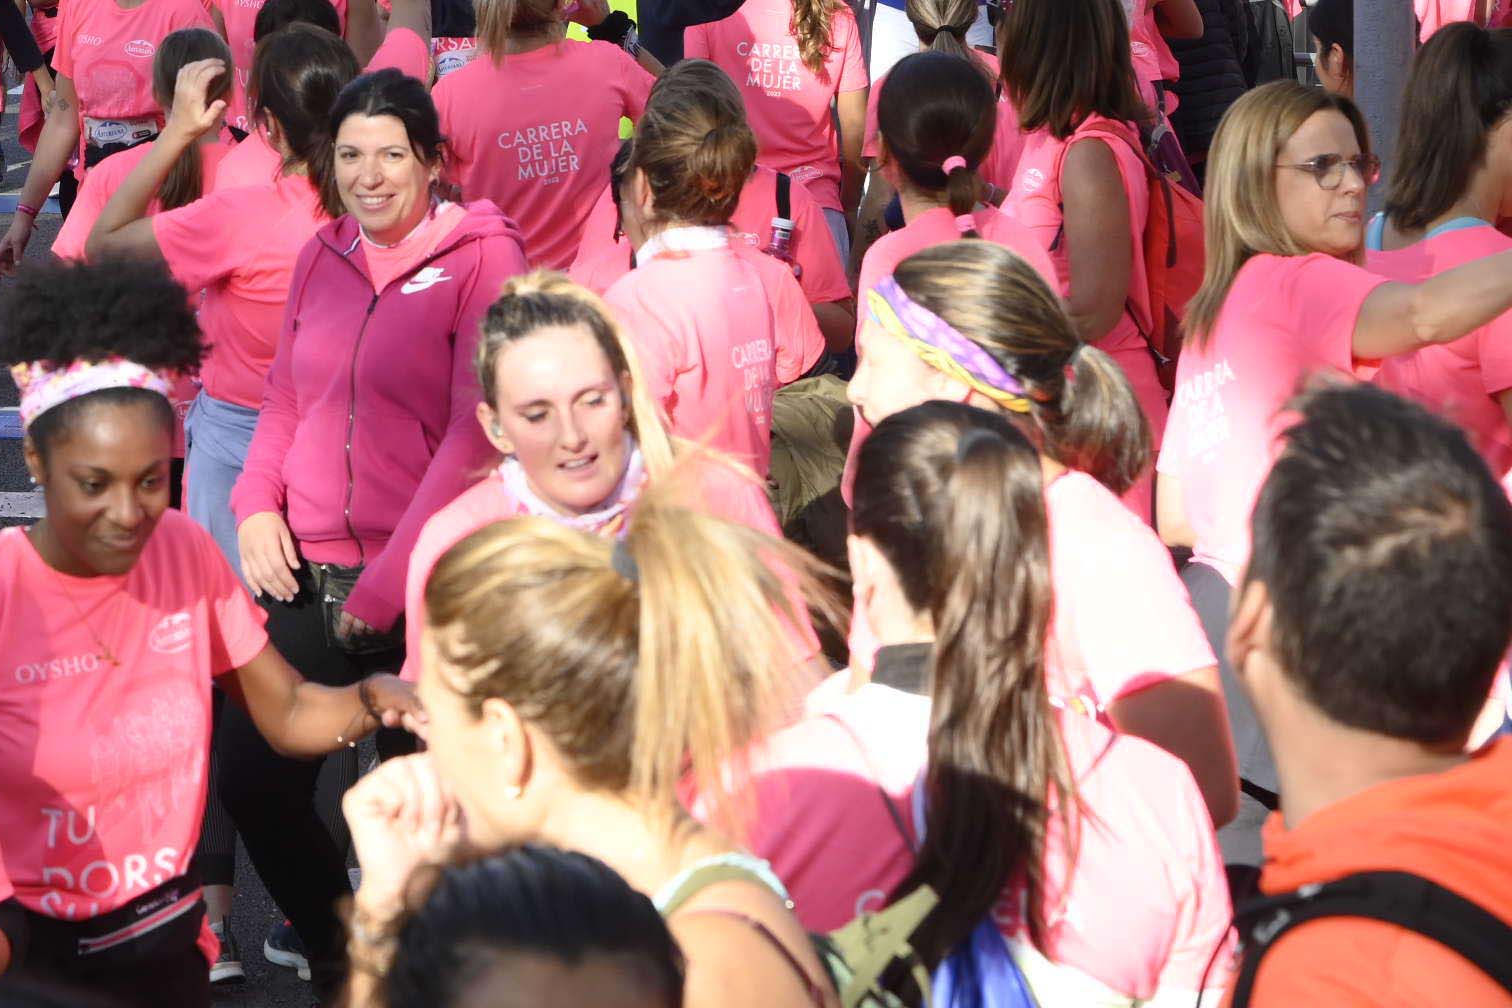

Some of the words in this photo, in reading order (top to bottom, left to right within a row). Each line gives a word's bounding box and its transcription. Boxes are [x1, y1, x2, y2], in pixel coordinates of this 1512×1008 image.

[751, 58, 776, 73] DE
[778, 59, 798, 74] LA
[746, 73, 800, 90] MUJER
[498, 119, 588, 149] CARRERA
[517, 146, 543, 164] DE
[550, 140, 574, 157] LA
[518, 156, 581, 181] MUJER
[14, 652, 99, 685] OYSHO
[41, 805, 96, 849] TU
